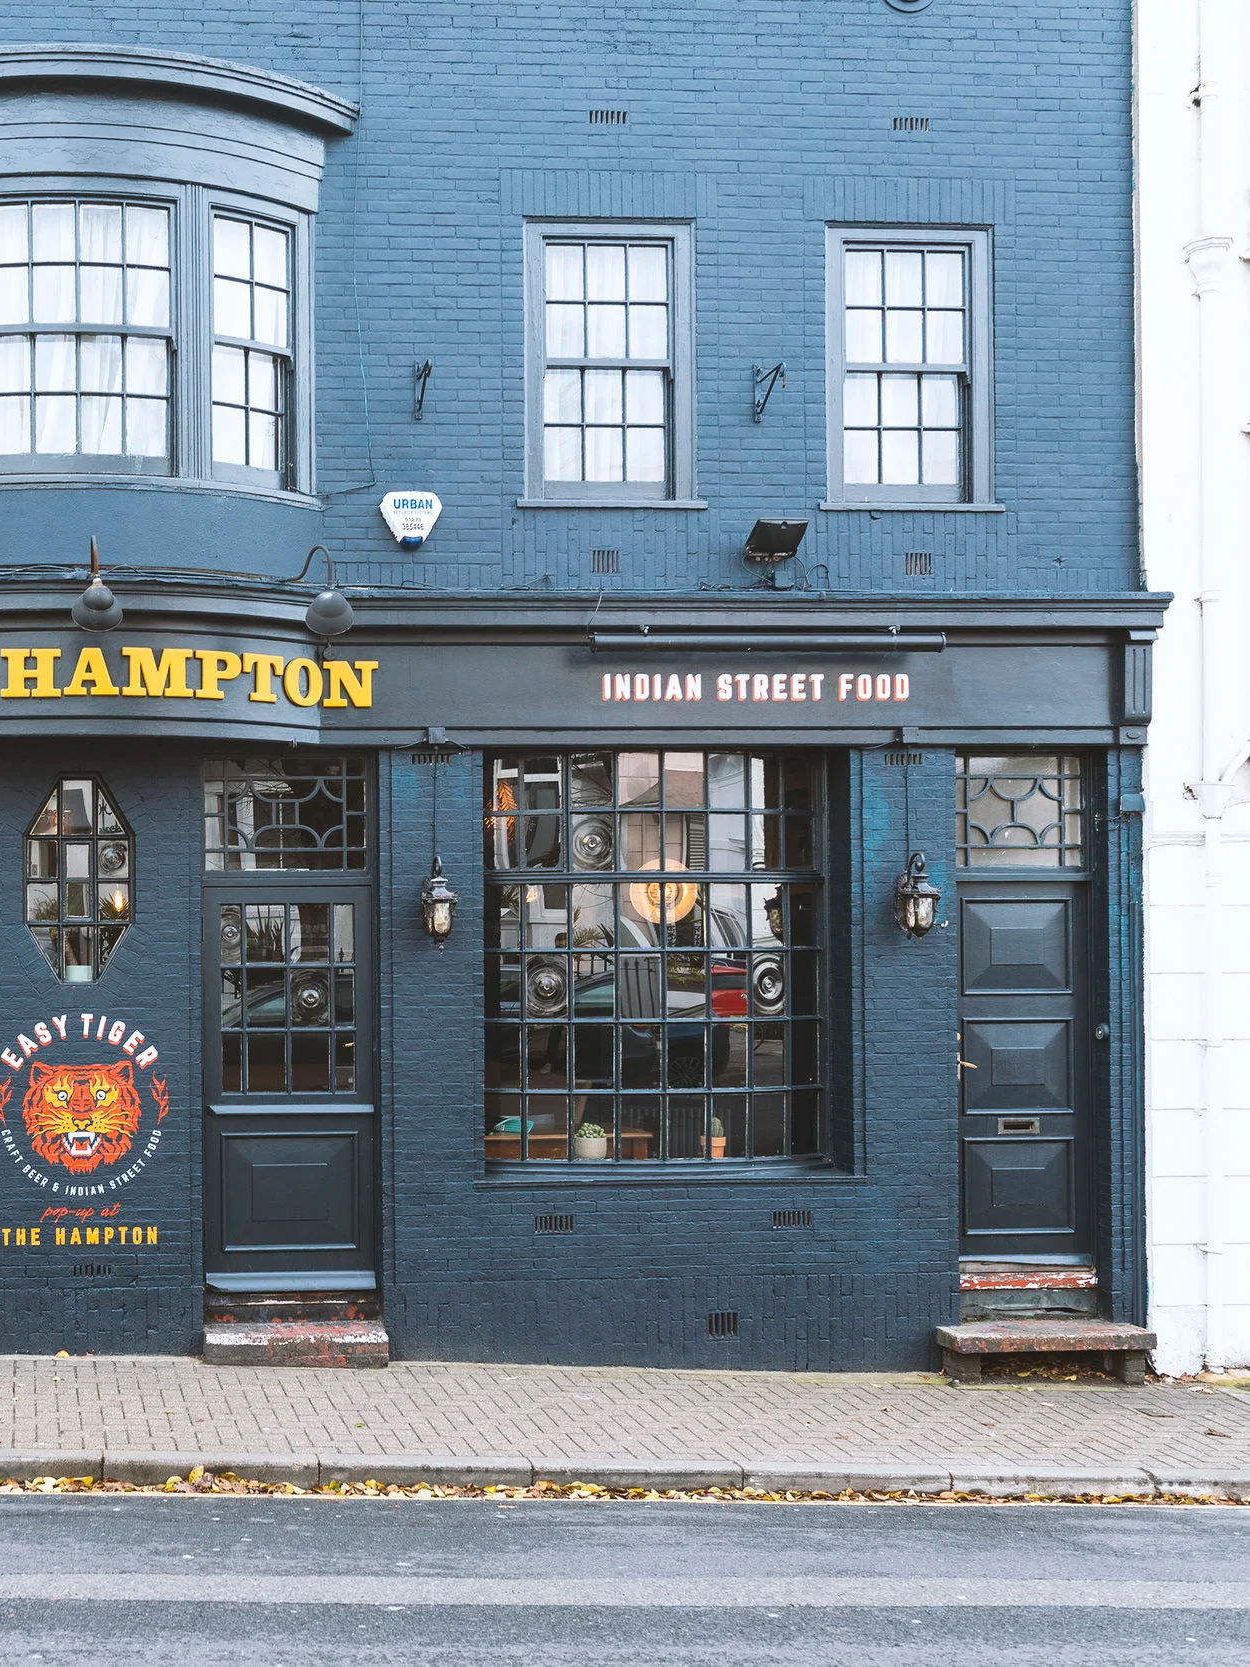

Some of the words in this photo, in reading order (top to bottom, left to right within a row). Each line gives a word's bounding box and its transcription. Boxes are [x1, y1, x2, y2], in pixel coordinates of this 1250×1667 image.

[393, 499, 433, 509] URBAN
[0, 646, 379, 709] HAMPTON
[602, 673, 702, 702] INDIAN
[716, 673, 825, 702] STREET
[837, 673, 910, 702] FOOD
[0, 1014, 68, 1071] EASY
[80, 1013, 159, 1070] TIGER
[1, 1128, 24, 1164] CRAFT
[22, 1164, 49, 1187] BEER
[52, 1182, 60, 1193] &
[64, 1183, 105, 1197] INDIAN
[108, 1158, 146, 1190] STREET
[143, 1129, 163, 1158] FOOD
[39, 1205, 95, 1224] pop-up
[100, 1202, 122, 1218] at
[1, 1227, 41, 1246] THE
[54, 1226, 159, 1246] HAMPTON
